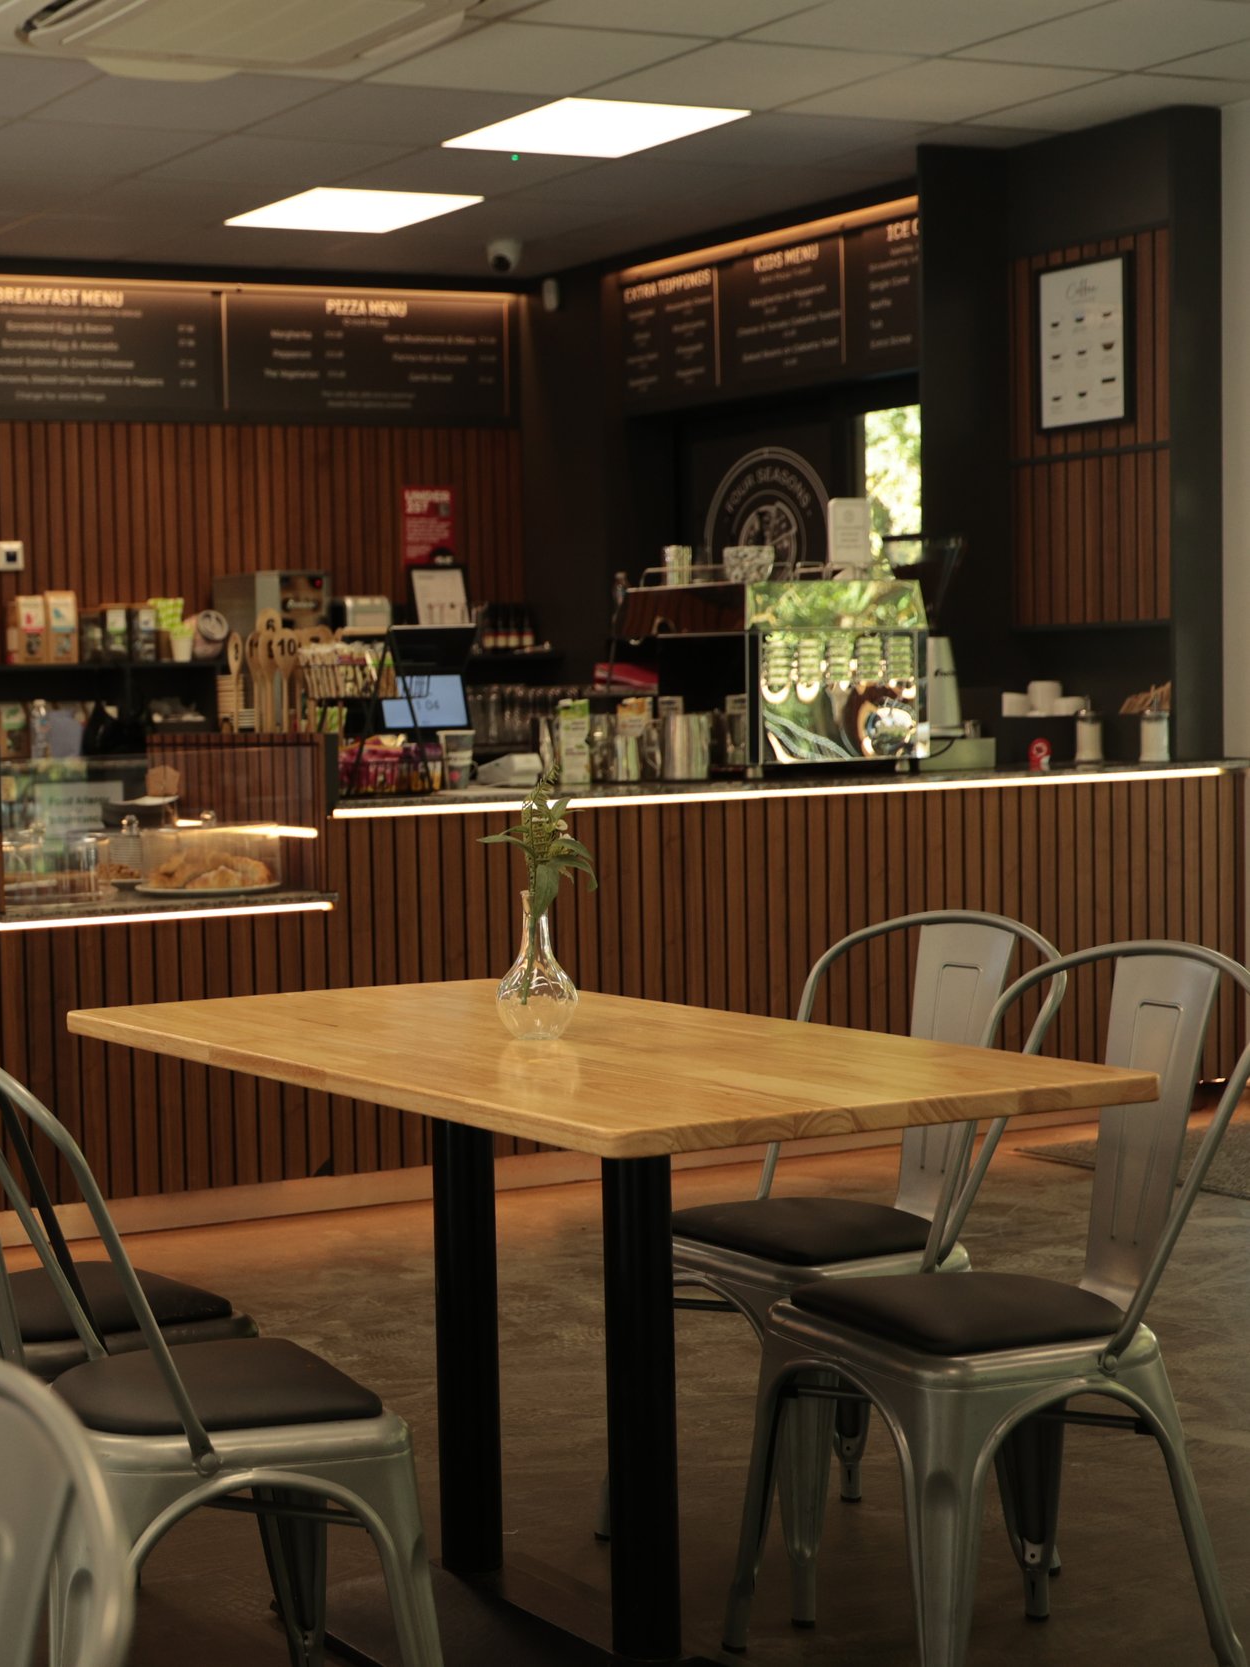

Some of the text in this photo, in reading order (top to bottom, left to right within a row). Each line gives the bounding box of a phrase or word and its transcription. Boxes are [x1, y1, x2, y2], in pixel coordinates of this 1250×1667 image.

[753, 243, 819, 273] KIDS MENU
[81, 288, 124, 308] MENU
[623, 268, 712, 304] EXTRA TOPPINGS
[325, 298, 408, 318] PIZZA MENU
[755, 465, 812, 509] SEASONS
[278, 638, 296, 656] 10
